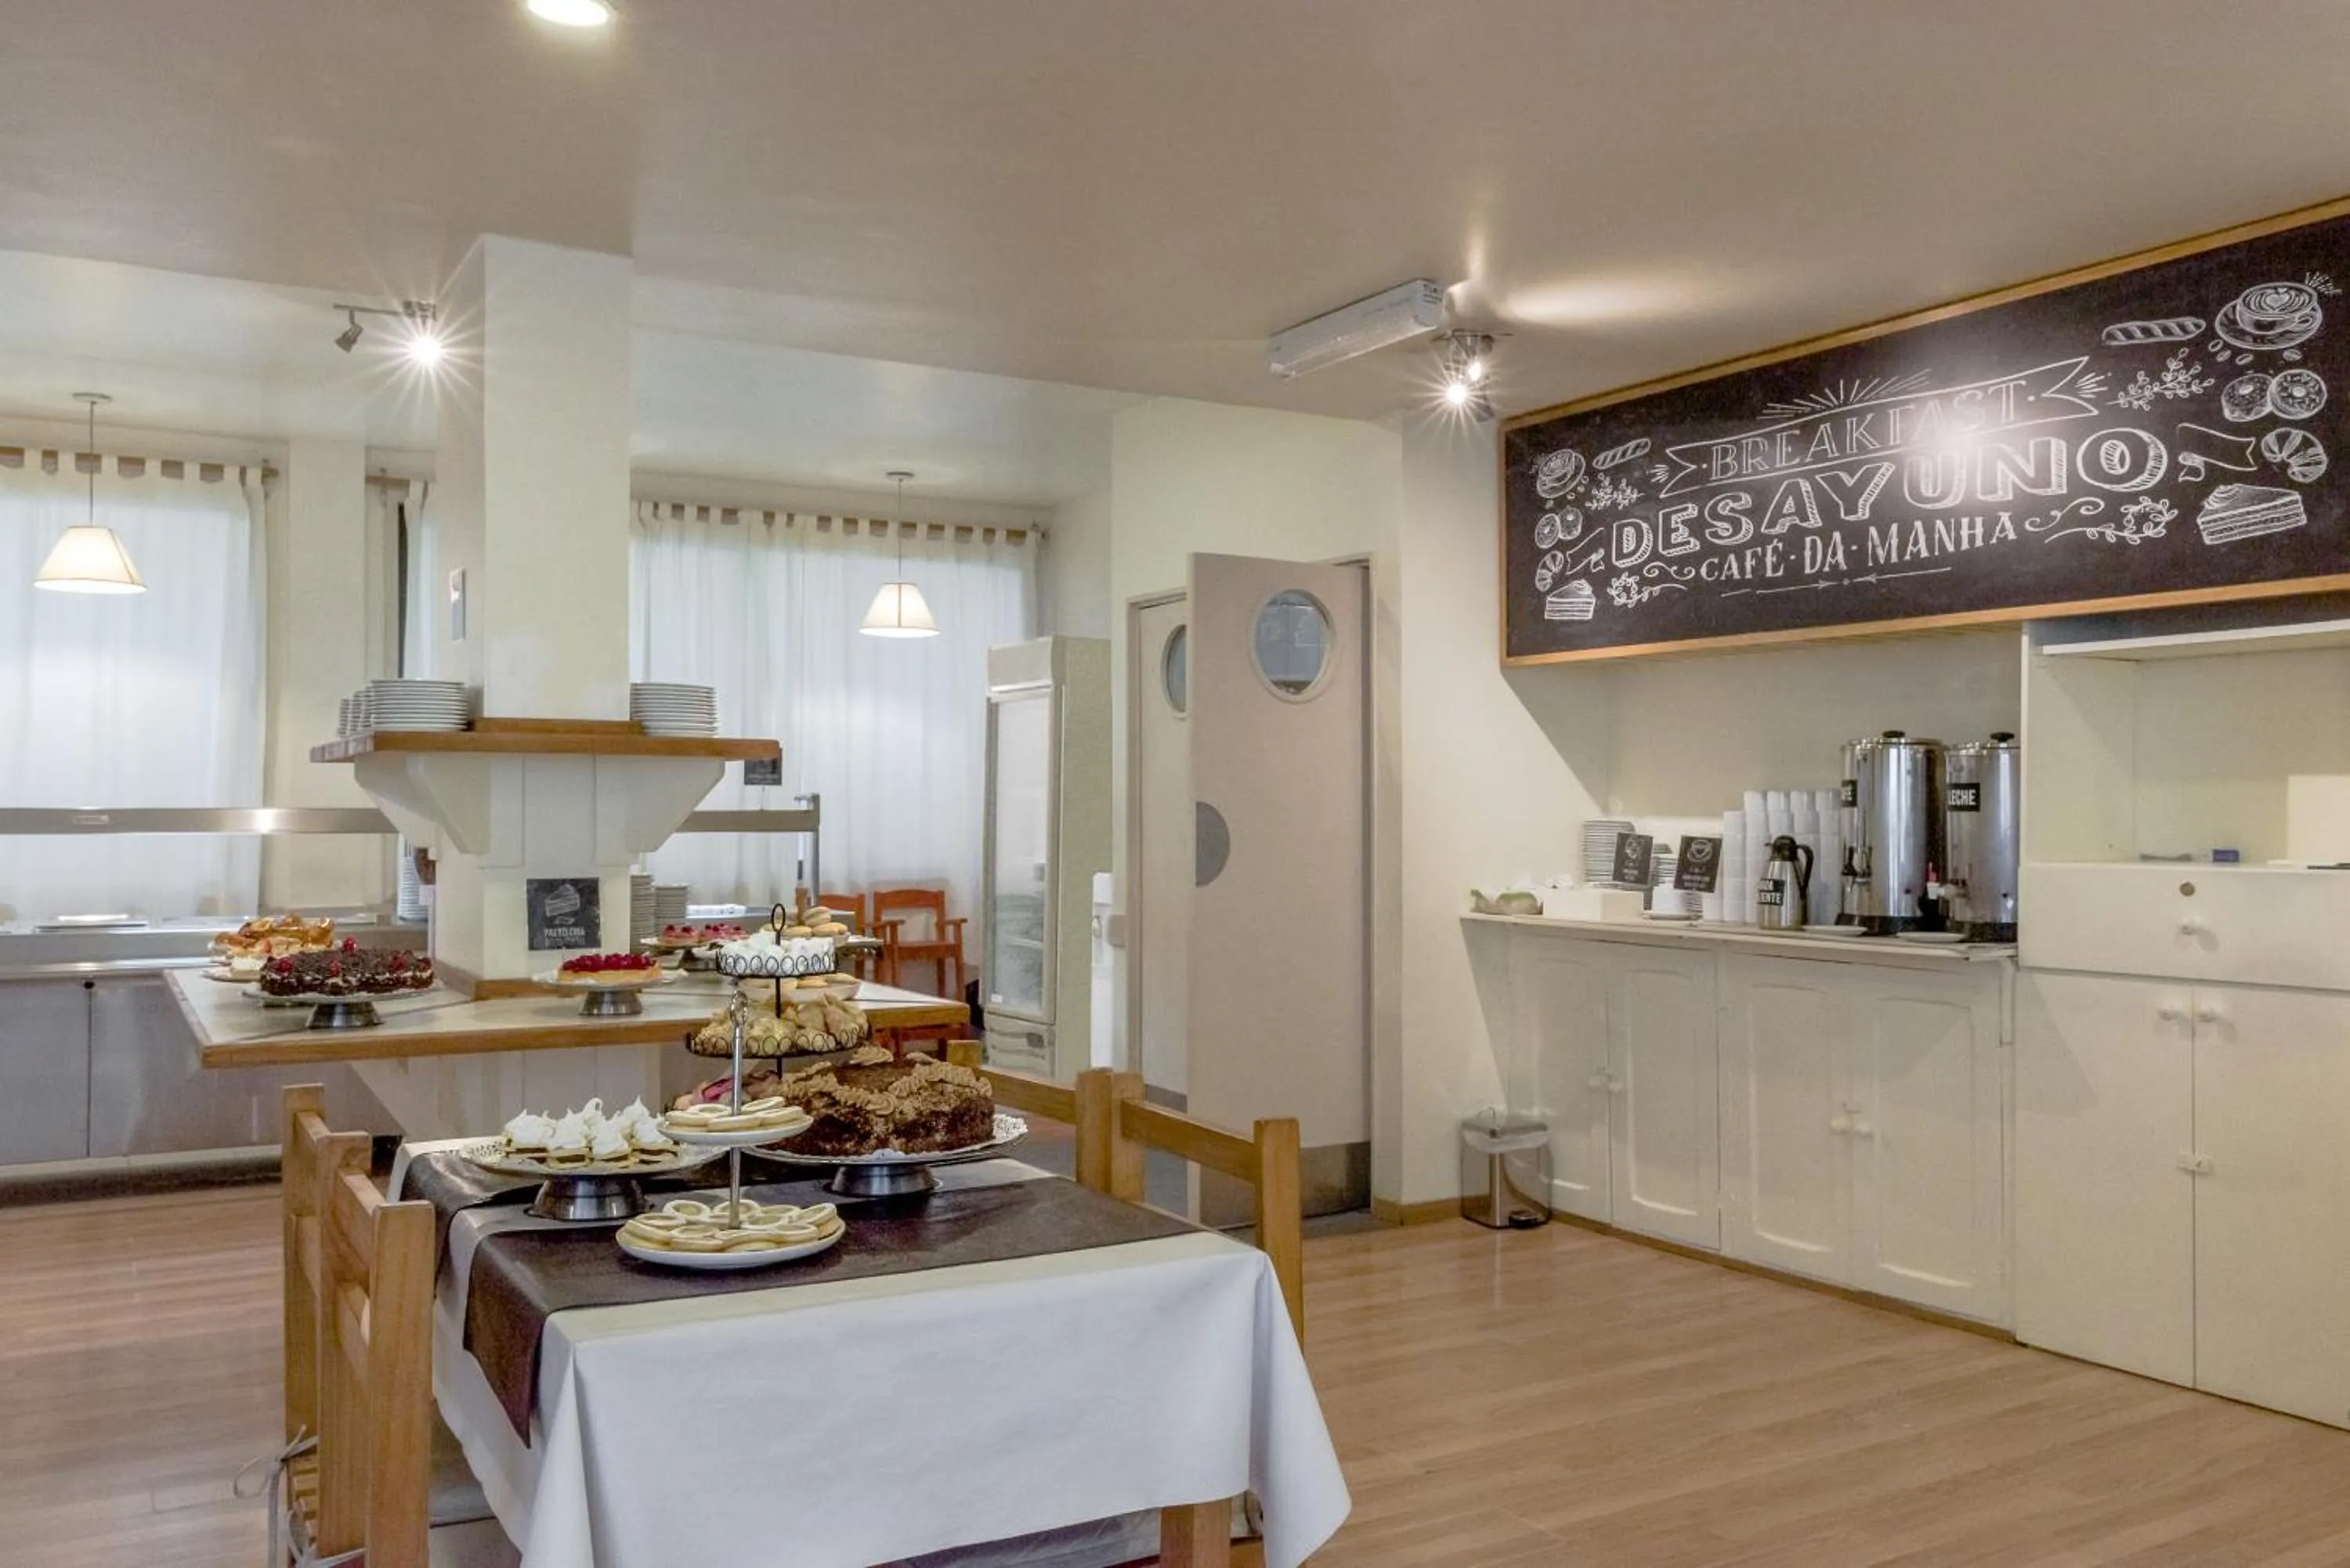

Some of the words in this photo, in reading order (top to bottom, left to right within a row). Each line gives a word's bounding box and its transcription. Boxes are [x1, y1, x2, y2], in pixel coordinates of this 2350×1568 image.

[1708, 379, 2027, 481] BREAKFAST
[1611, 428, 2167, 569] DESAYUNO
[1701, 540, 1784, 581] CAFÉ
[1803, 530, 1847, 574] DA
